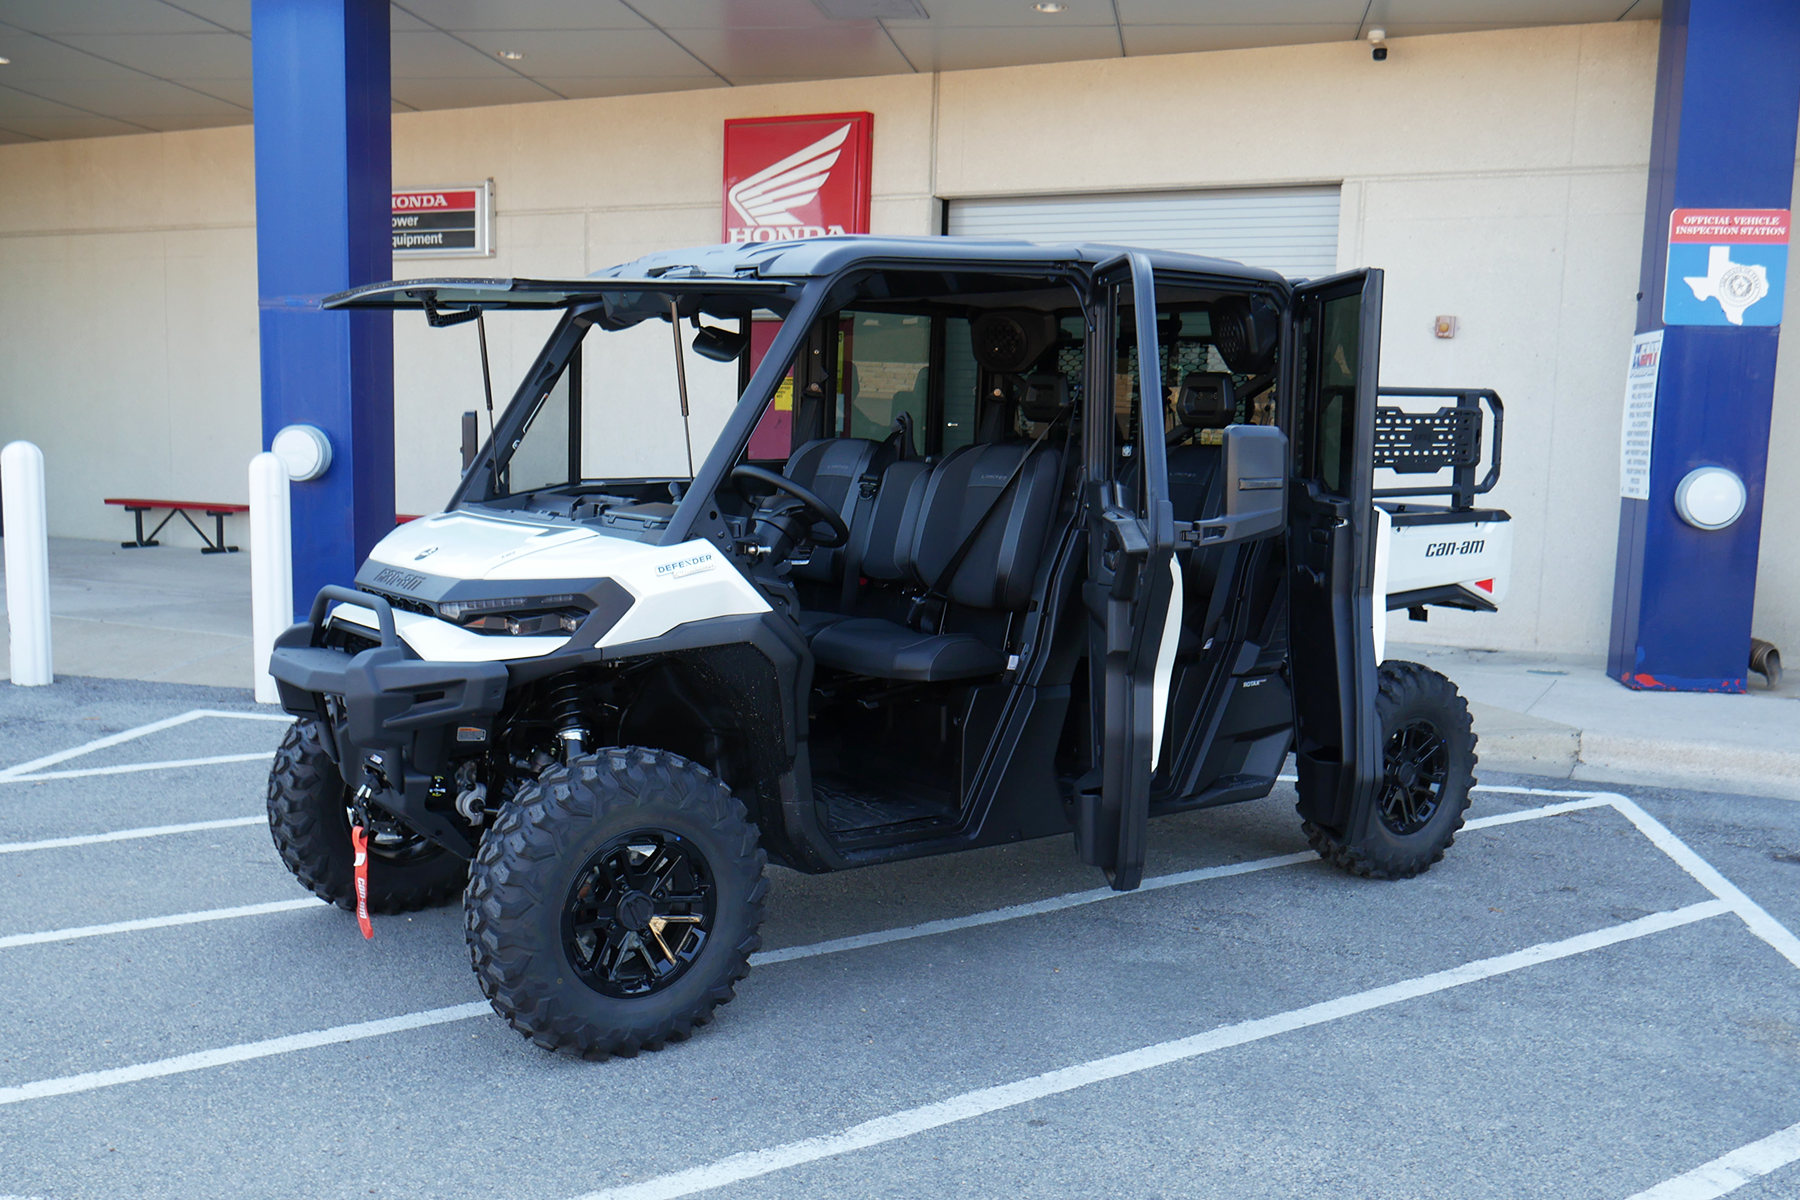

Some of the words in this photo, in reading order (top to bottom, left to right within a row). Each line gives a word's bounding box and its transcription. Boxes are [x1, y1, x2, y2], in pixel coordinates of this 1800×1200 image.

[392, 215, 419, 228] ower
[1683, 215, 1732, 226] OFFICIAL
[1734, 216, 1781, 226] VEHICLE
[1675, 226, 1738, 236] INSPECTION
[1740, 226, 1786, 236] STATION
[392, 232, 443, 248] quipment
[1425, 539, 1485, 557] can-am
[657, 554, 712, 573] DEFENDER
